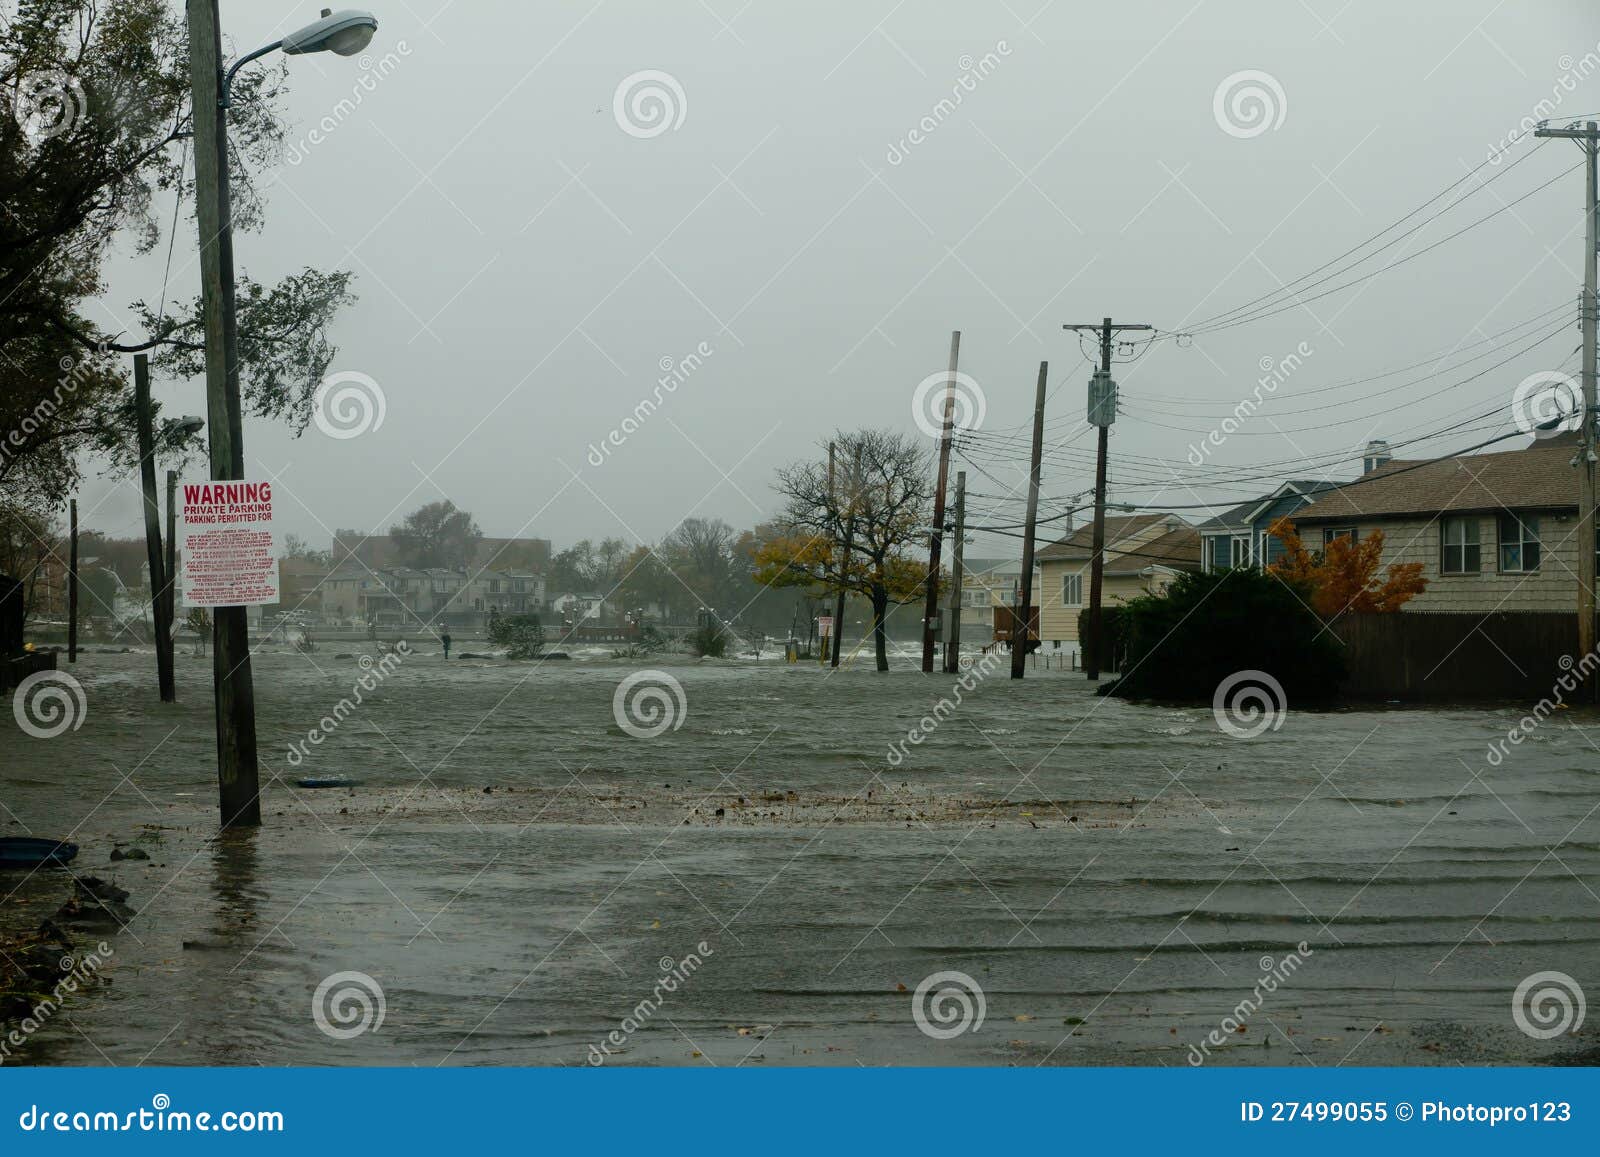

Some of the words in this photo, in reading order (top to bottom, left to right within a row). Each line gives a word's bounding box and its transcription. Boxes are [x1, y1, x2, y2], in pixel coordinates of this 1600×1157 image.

[184, 482, 272, 505] WARNING
[184, 505, 226, 515] PRIVATE
[229, 503, 272, 513] PARKING
[184, 515, 215, 524] PARKING
[218, 513, 257, 524] PERMITTED
[258, 512, 272, 521] FOR
